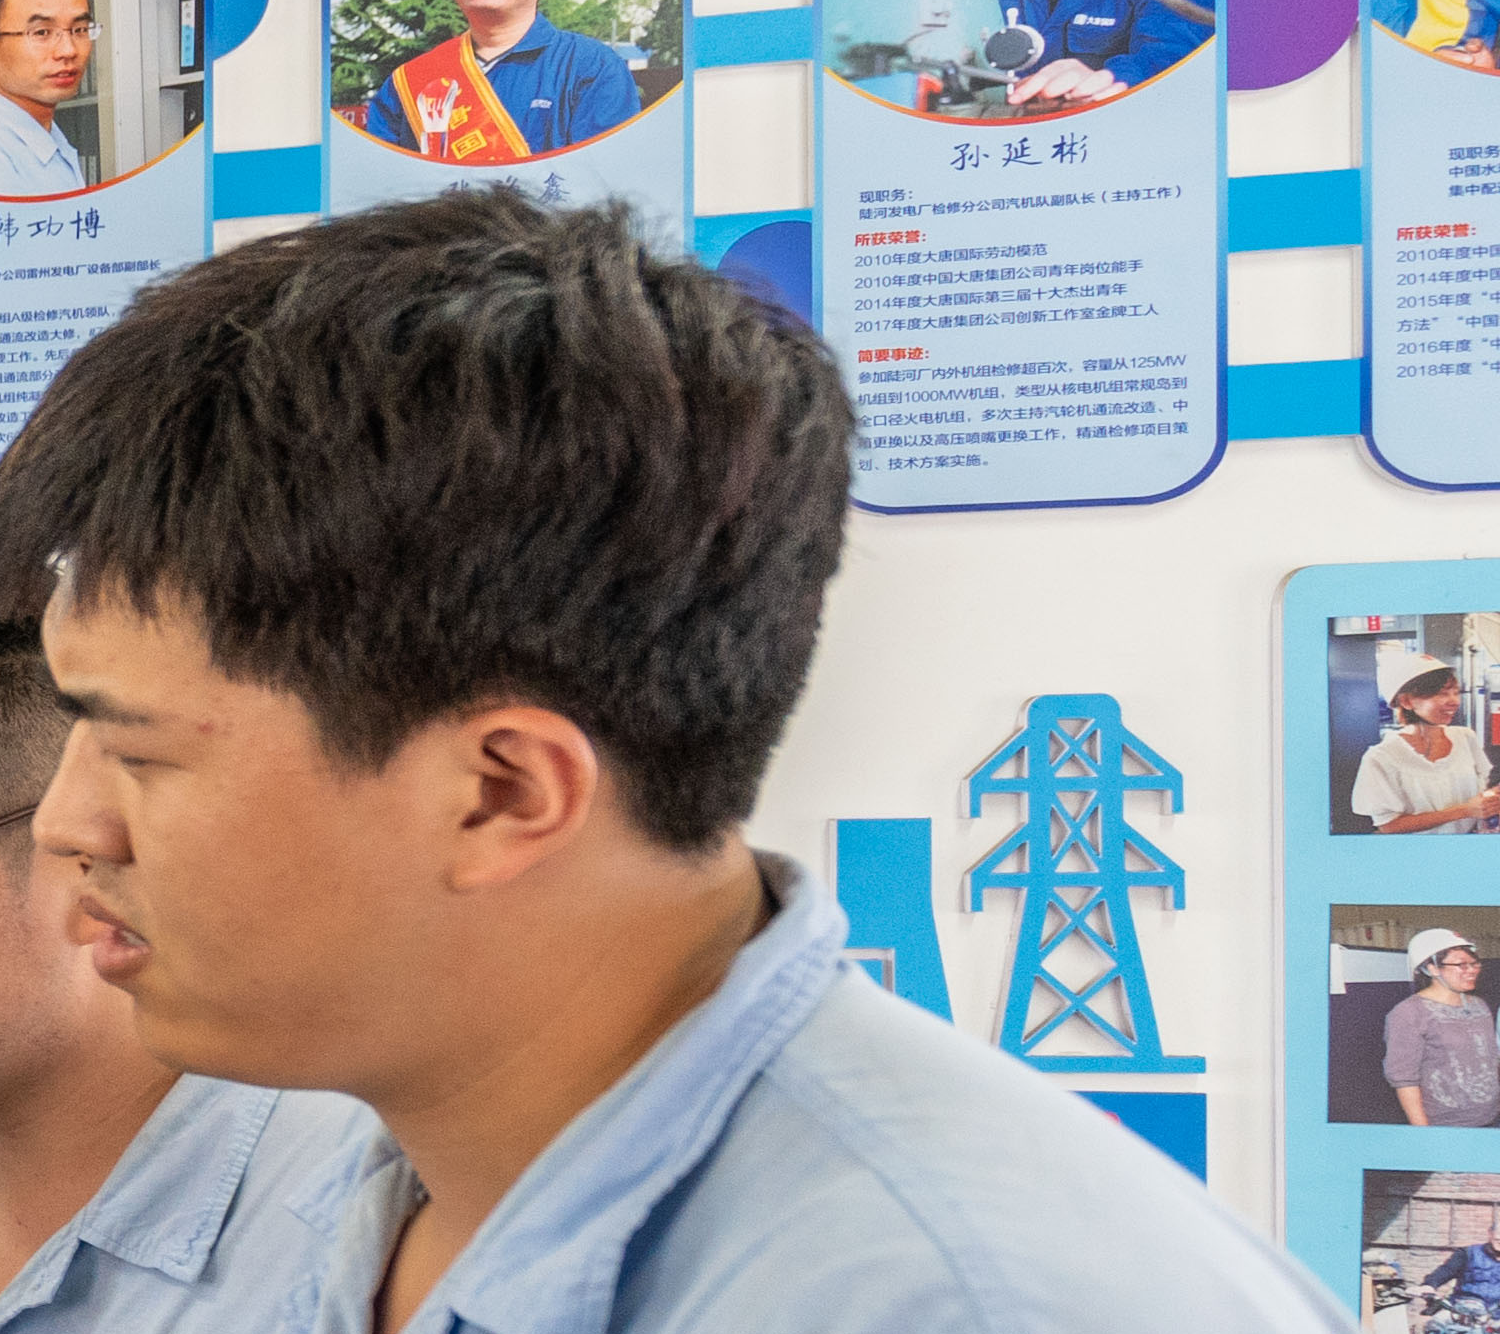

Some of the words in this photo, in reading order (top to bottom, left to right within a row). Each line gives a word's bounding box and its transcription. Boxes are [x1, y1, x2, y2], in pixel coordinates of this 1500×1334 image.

[950, 132, 1088, 171] 孙延彬
[1448, 183, 1500, 198] 集中配
[854, 243, 1048, 267] 2010年度大唐国际劳动模范
[854, 259, 1143, 289] 2010年度中国大唐集团公司青年岗位能手
[854, 283, 1128, 311] 2014年度大唐国际第三届十大杰出青年
[854, 303, 1159, 333] 2017年度大唐集团公司创新工作室金牌工人
